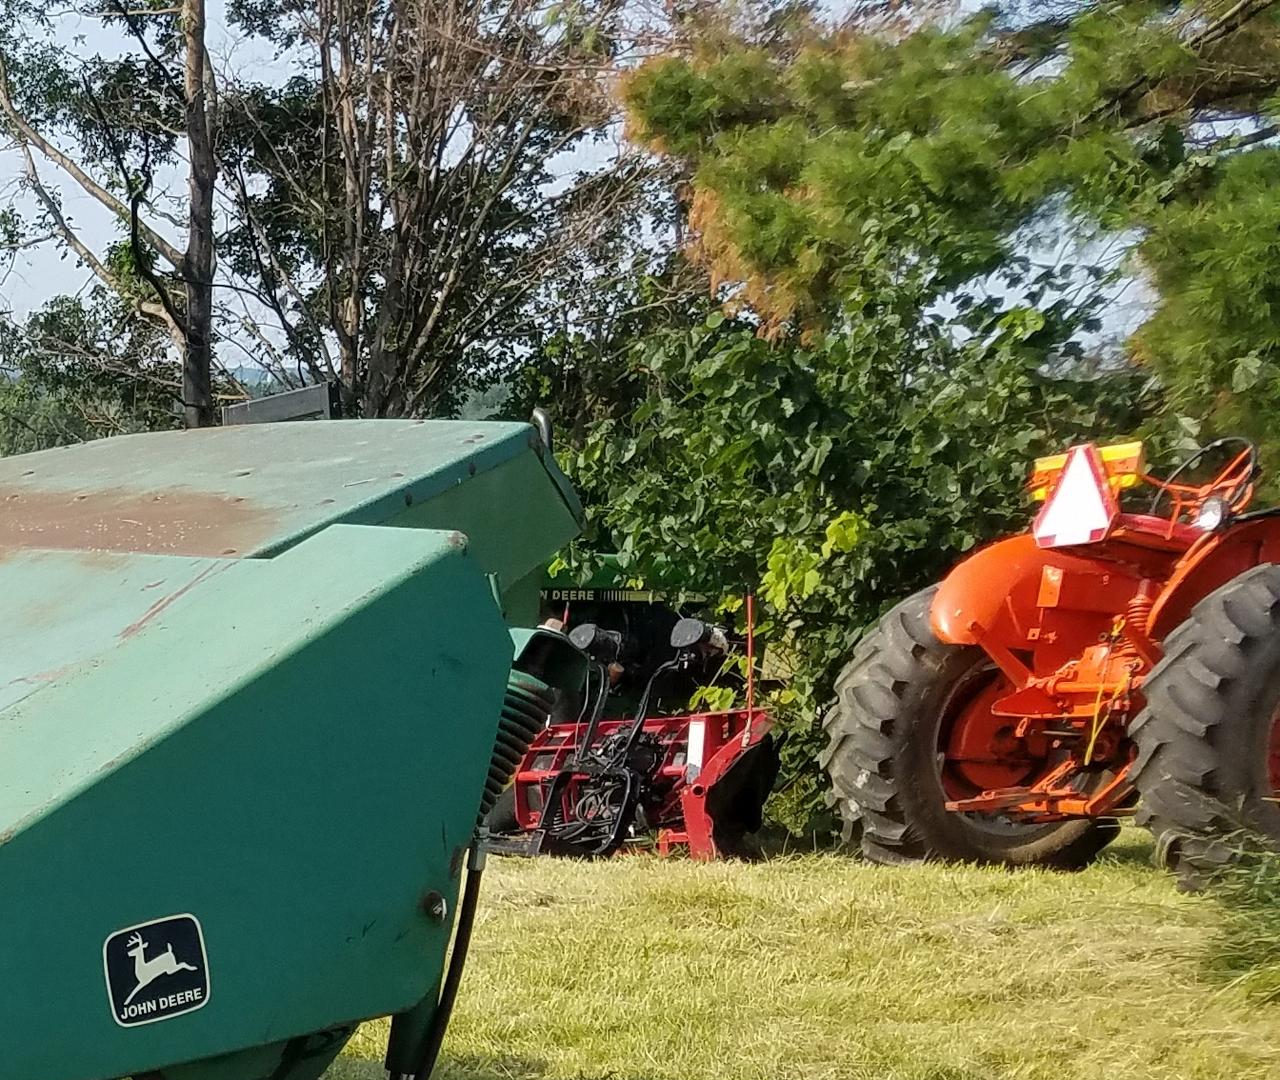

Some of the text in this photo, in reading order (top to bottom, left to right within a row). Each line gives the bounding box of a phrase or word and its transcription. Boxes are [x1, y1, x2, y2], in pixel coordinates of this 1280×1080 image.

[552, 590, 595, 601] DEERE
[120, 987, 203, 1020] JOHN DEERE
